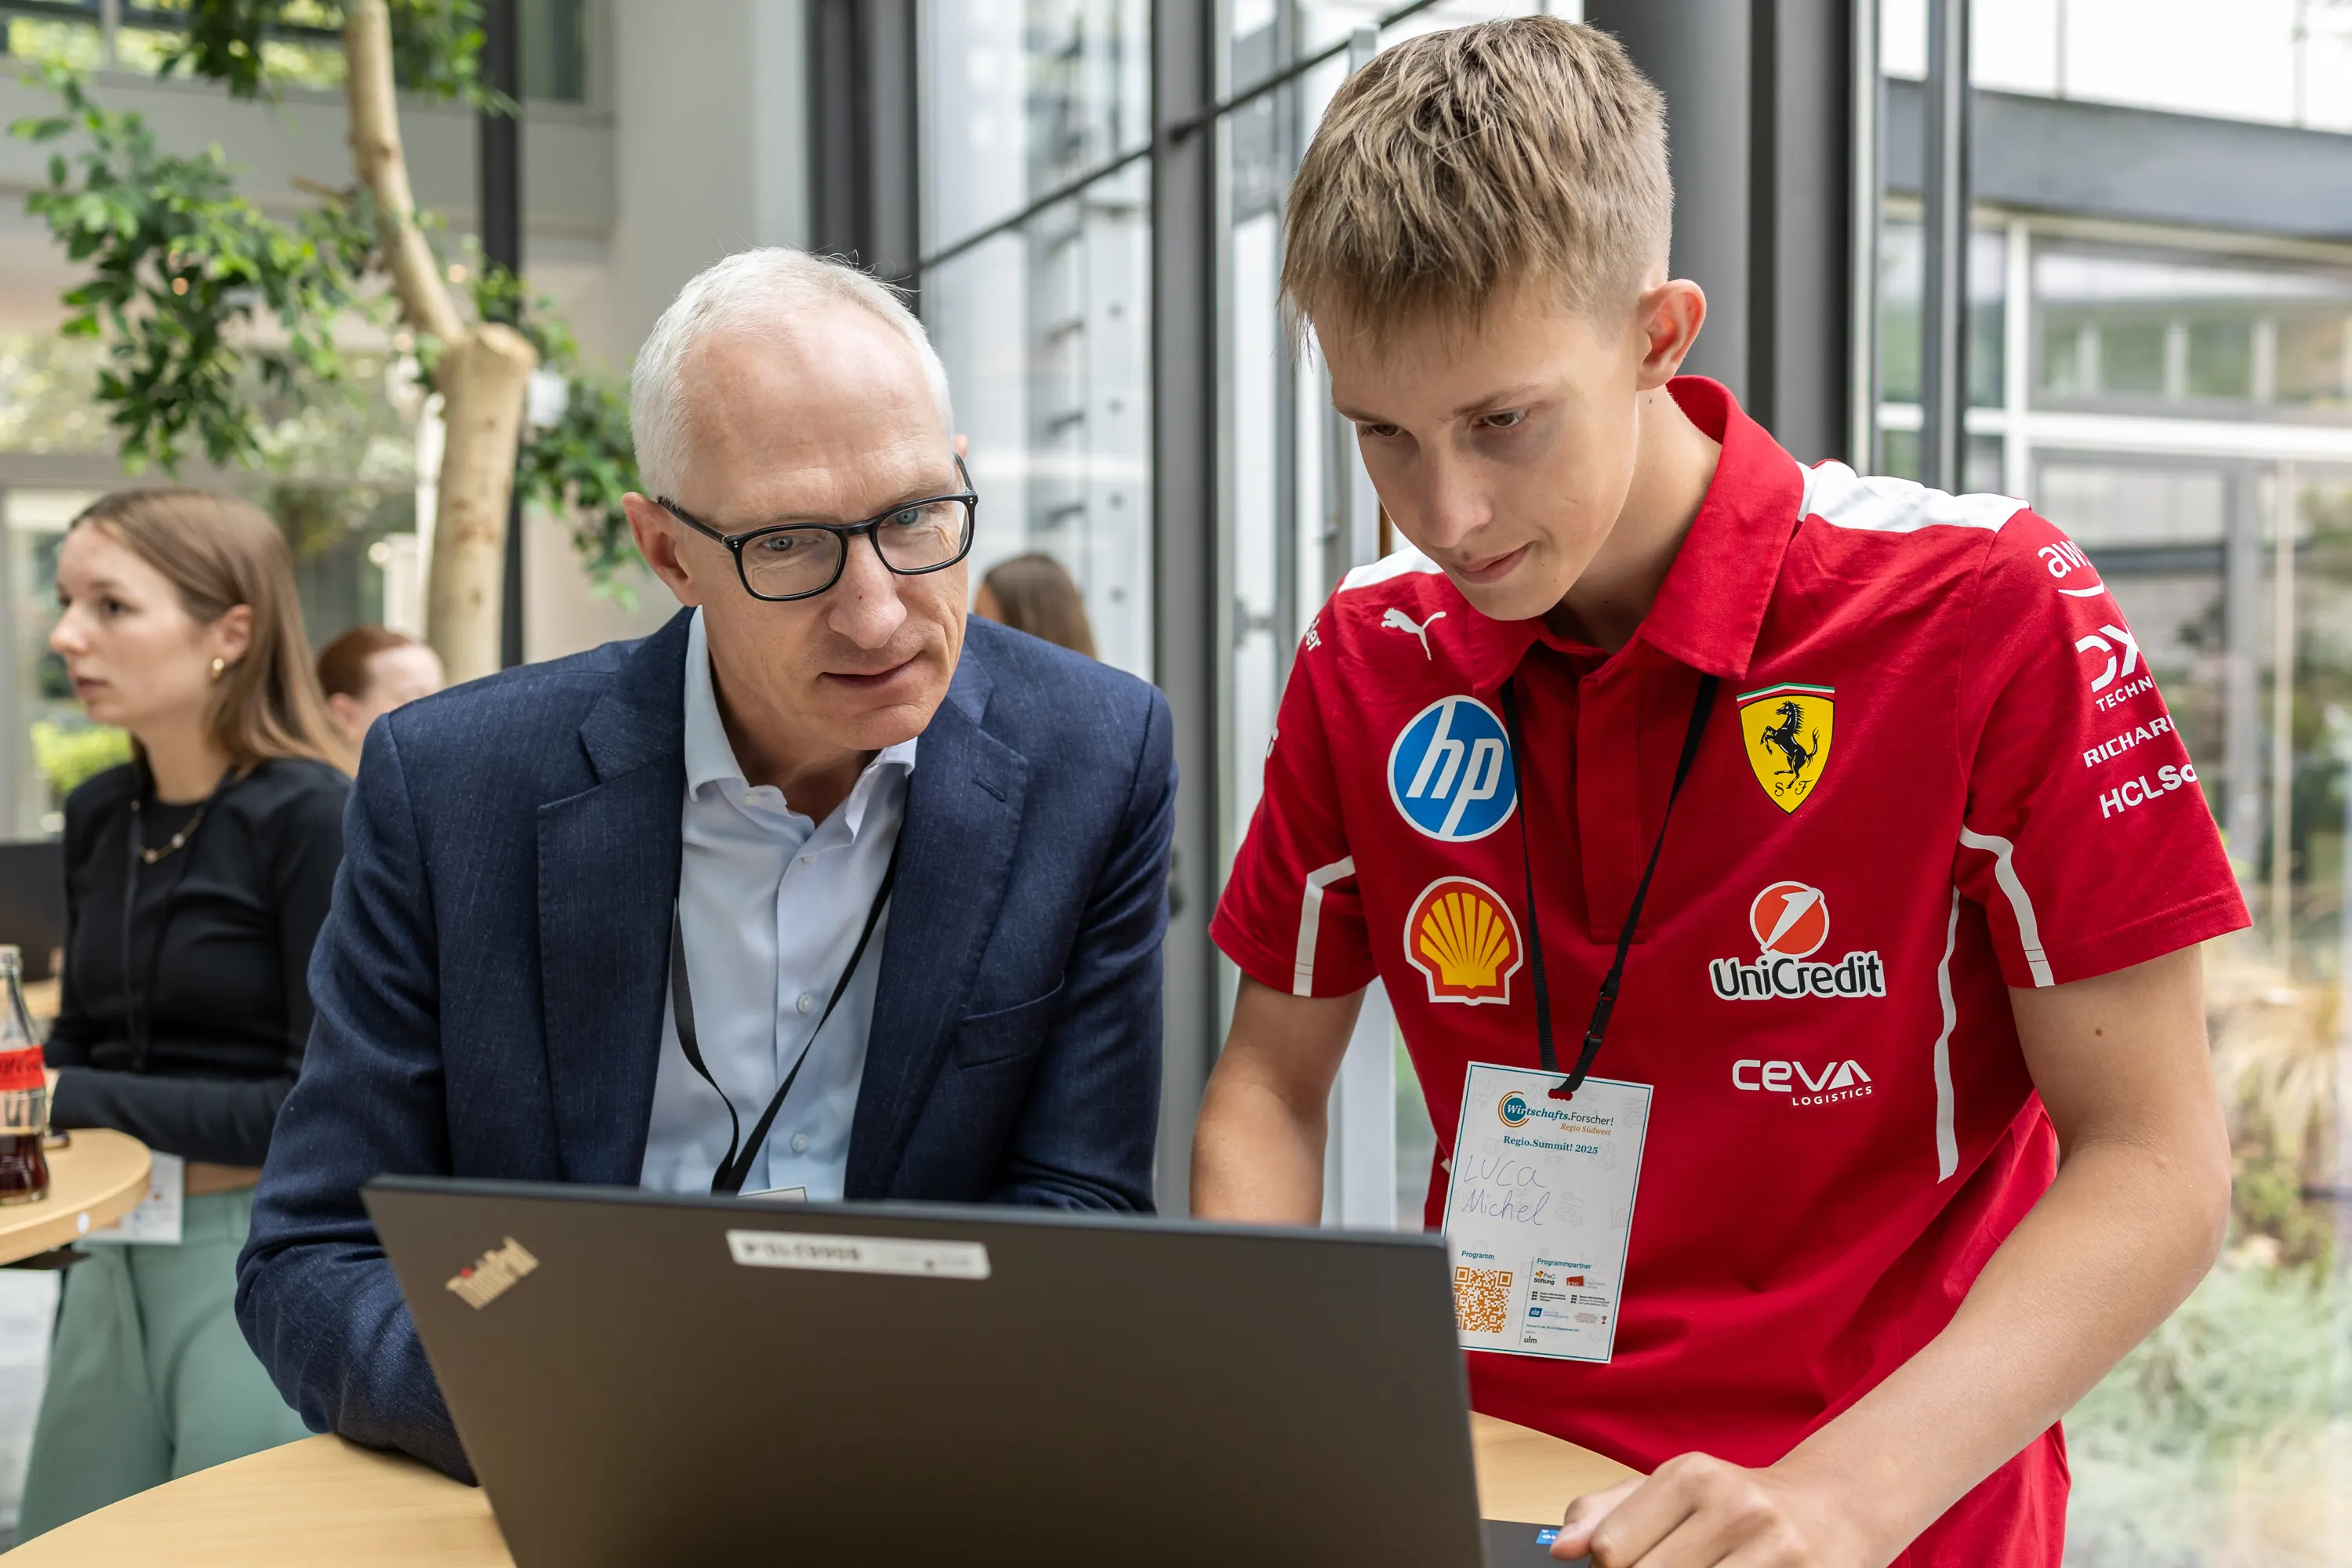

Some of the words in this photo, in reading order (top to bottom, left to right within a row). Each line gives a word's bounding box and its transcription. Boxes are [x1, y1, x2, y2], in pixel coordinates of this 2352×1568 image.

[2095, 675, 2154, 712] TECHN
[2082, 714, 2175, 768] RICHAR
[1406, 700, 1504, 837] hp
[1774, 782, 1784, 797] S
[2099, 764, 2198, 819] HCLSo
[1712, 955, 1882, 996] UniCredit
[1792, 1086, 1872, 1106] LOGISTICS
[1560, 1123, 1581, 1133] Regio
[1581, 1124, 1612, 1136] Südwest
[1503, 1135, 1573, 1152] Regio.Summit!
[1574, 1144, 1599, 1155] 2025
[1461, 1189, 1551, 1225] Michel
[1461, 1250, 1495, 1260] Programm
[1537, 1258, 1592, 1270] Programmpartner
[1534, 1277, 1555, 1286] Stiftung
[1523, 1335, 1537, 1344] ulm
